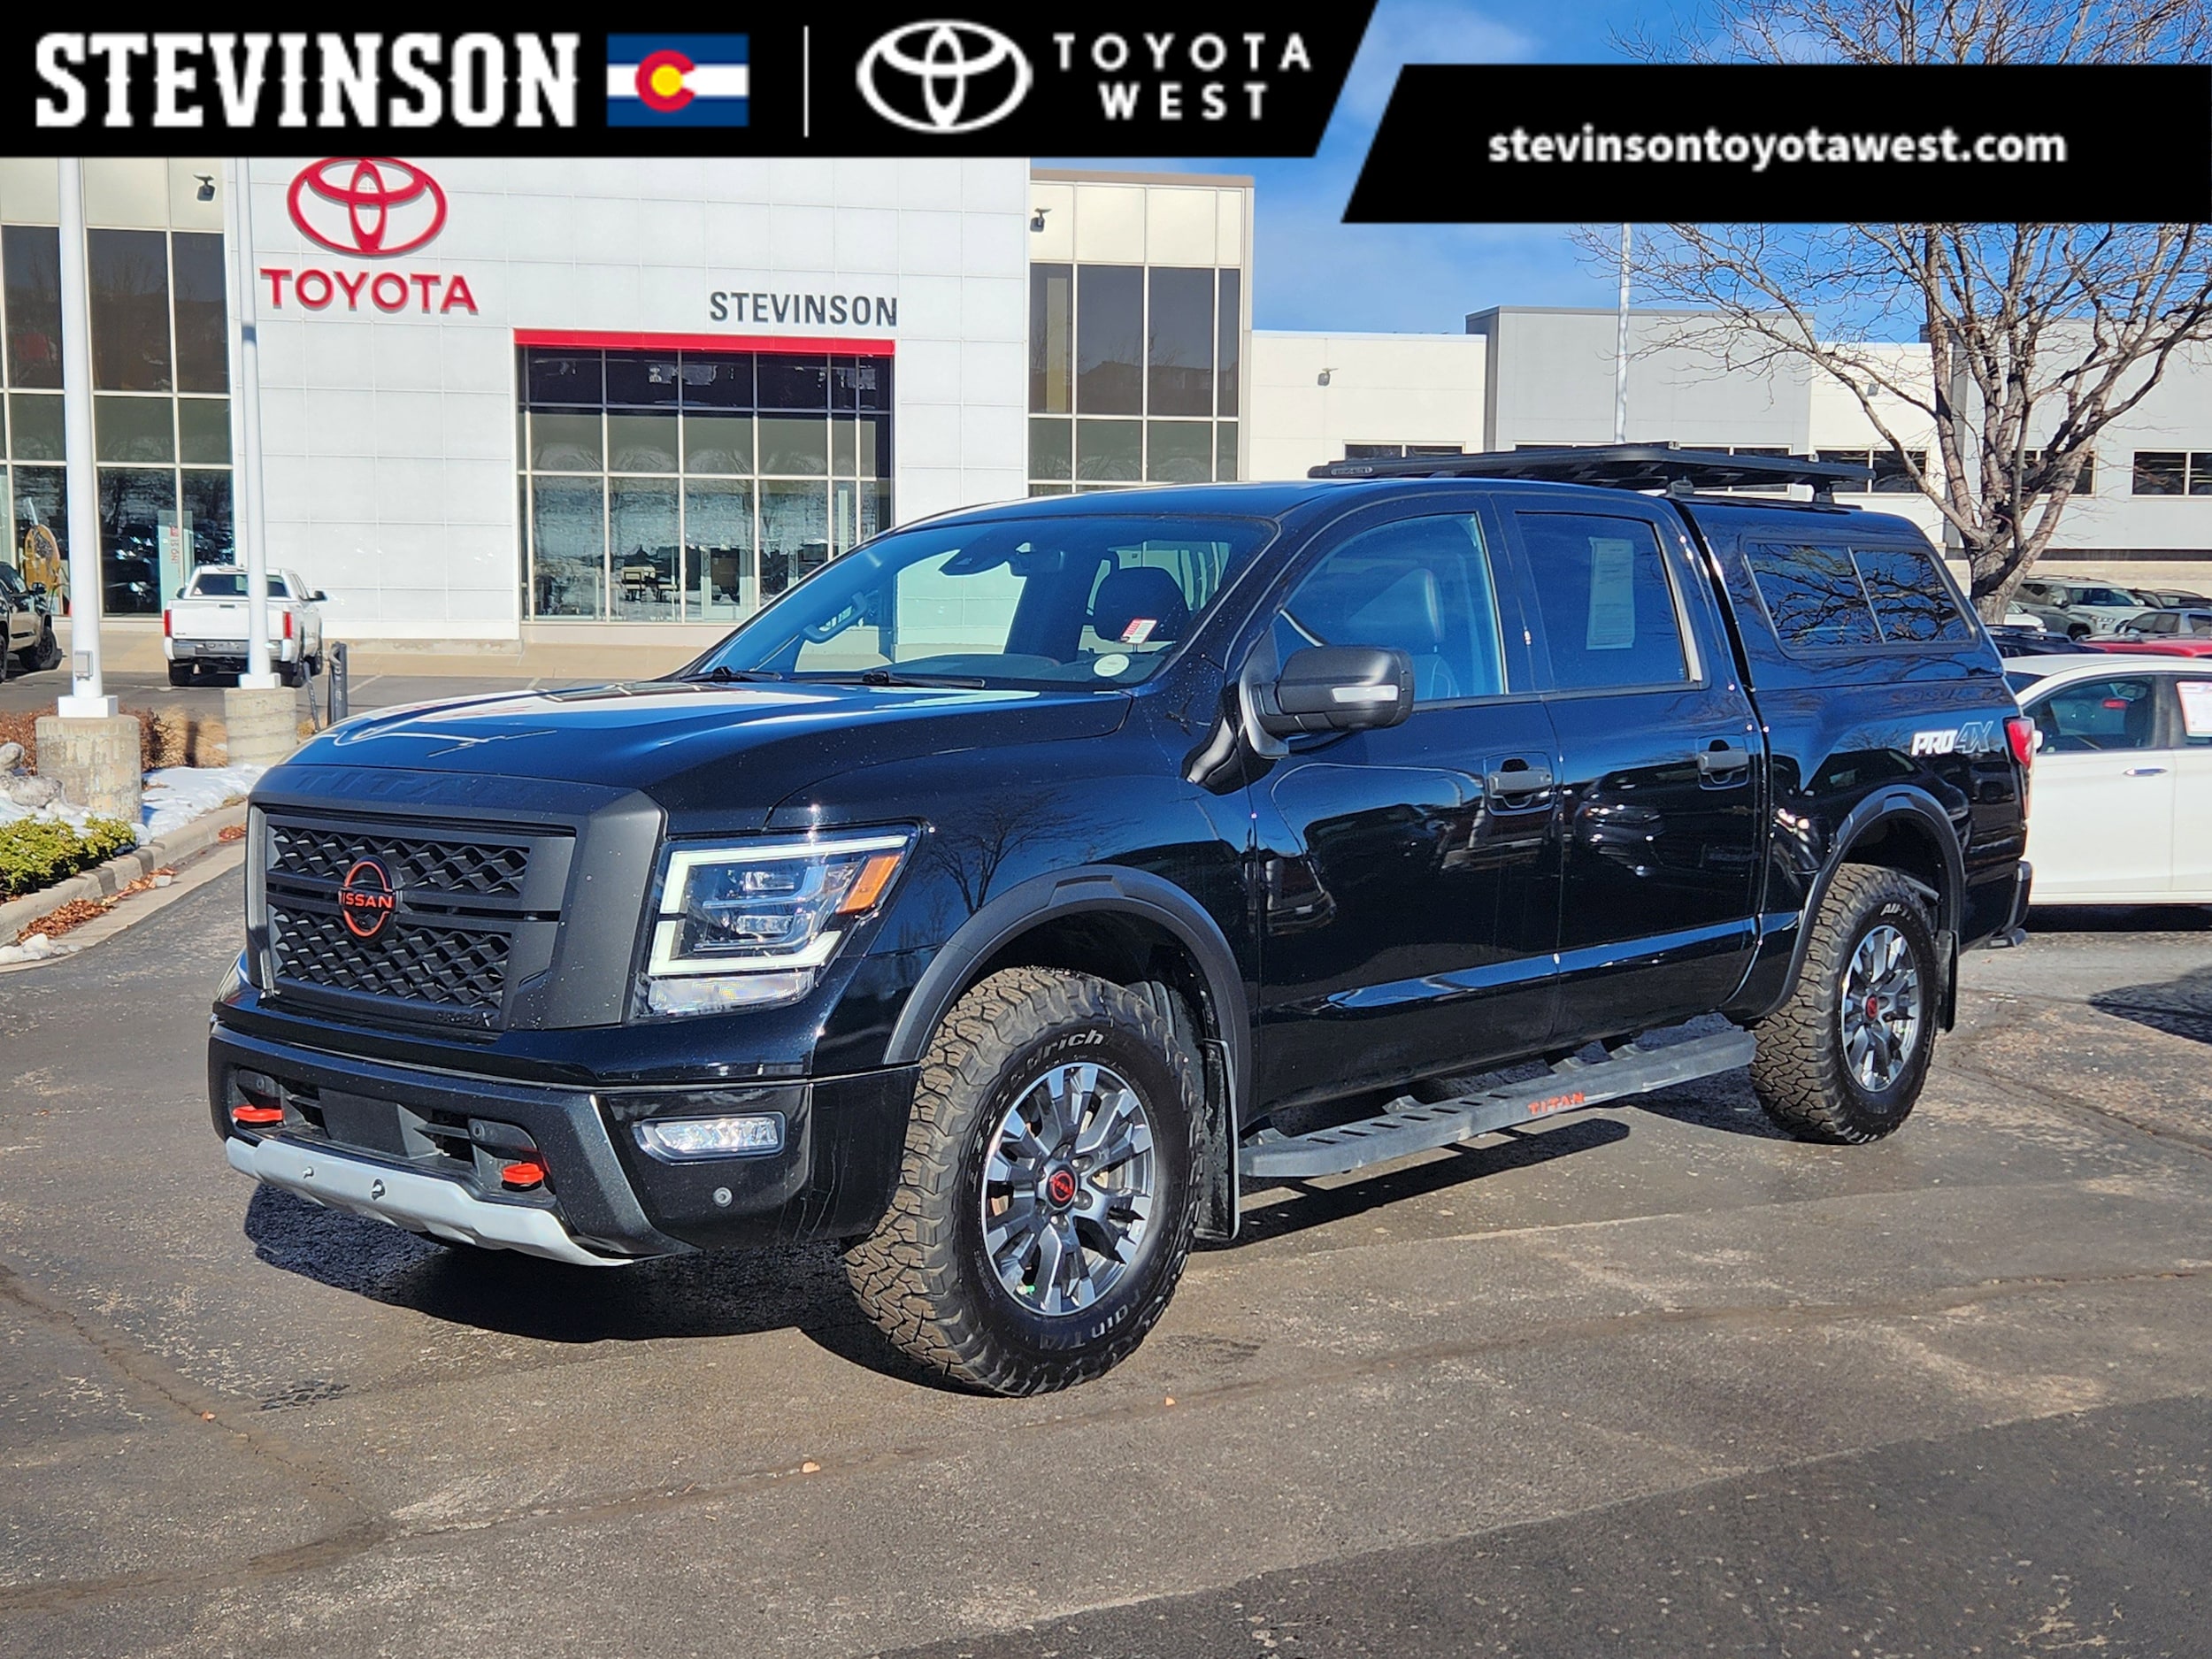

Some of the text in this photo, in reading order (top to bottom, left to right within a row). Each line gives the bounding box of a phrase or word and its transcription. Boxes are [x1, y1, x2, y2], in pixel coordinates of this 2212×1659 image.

[260, 268, 478, 313] TOYOTA
[710, 291, 898, 326] STEVINSON
[1527, 1091, 1586, 1116] TITAN
